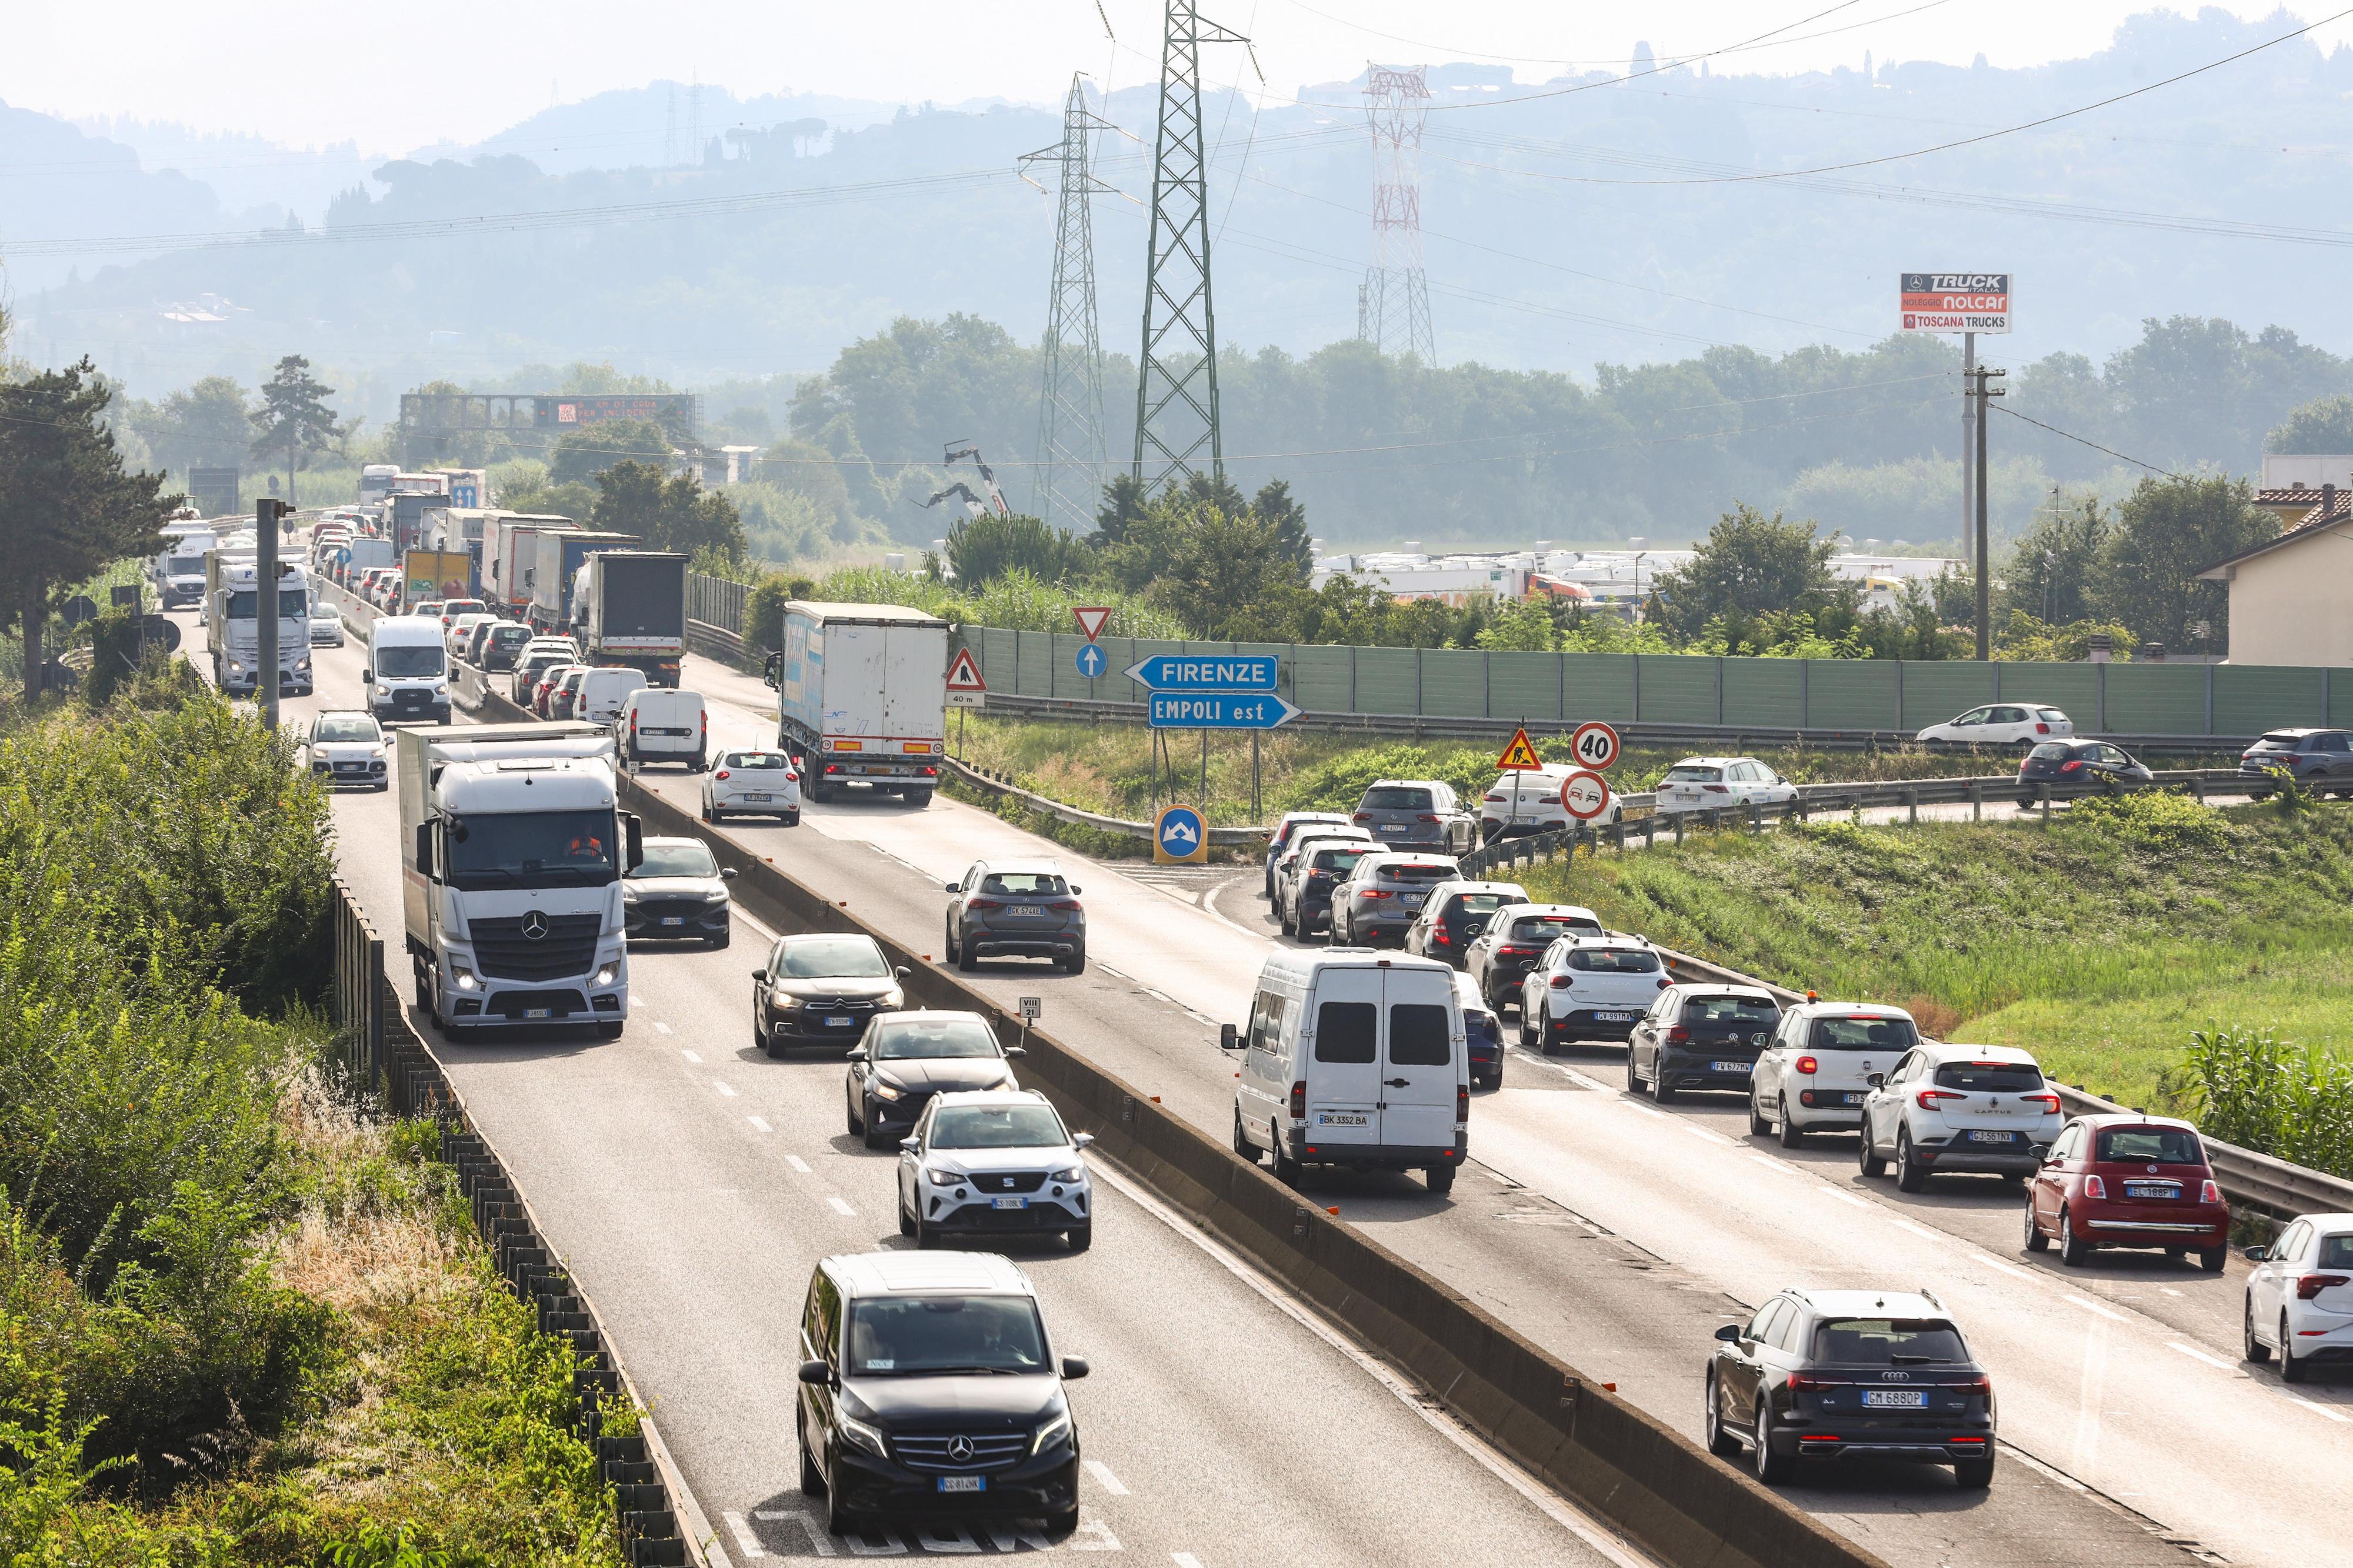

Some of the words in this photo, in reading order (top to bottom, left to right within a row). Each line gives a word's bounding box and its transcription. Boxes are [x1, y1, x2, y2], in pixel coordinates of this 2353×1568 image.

[1931, 275, 2002, 292] TRUCK
[1903, 298, 1941, 306] NOLEGGIO
[1917, 316, 1964, 327] TOSCANA
[1965, 316, 2005, 327] TRUCKS
[1162, 663, 1266, 682] FIRENZE
[1155, 701, 1221, 720] EMPOLI
[1234, 702, 1264, 720] est
[1580, 735, 1608, 759] 40
[1974, 1132, 1984, 1140] GJ
[1987, 1132, 2010, 1141] 561NX
[1869, 1393, 1882, 1404] GM
[1887, 1393, 1920, 1404] 688DP
